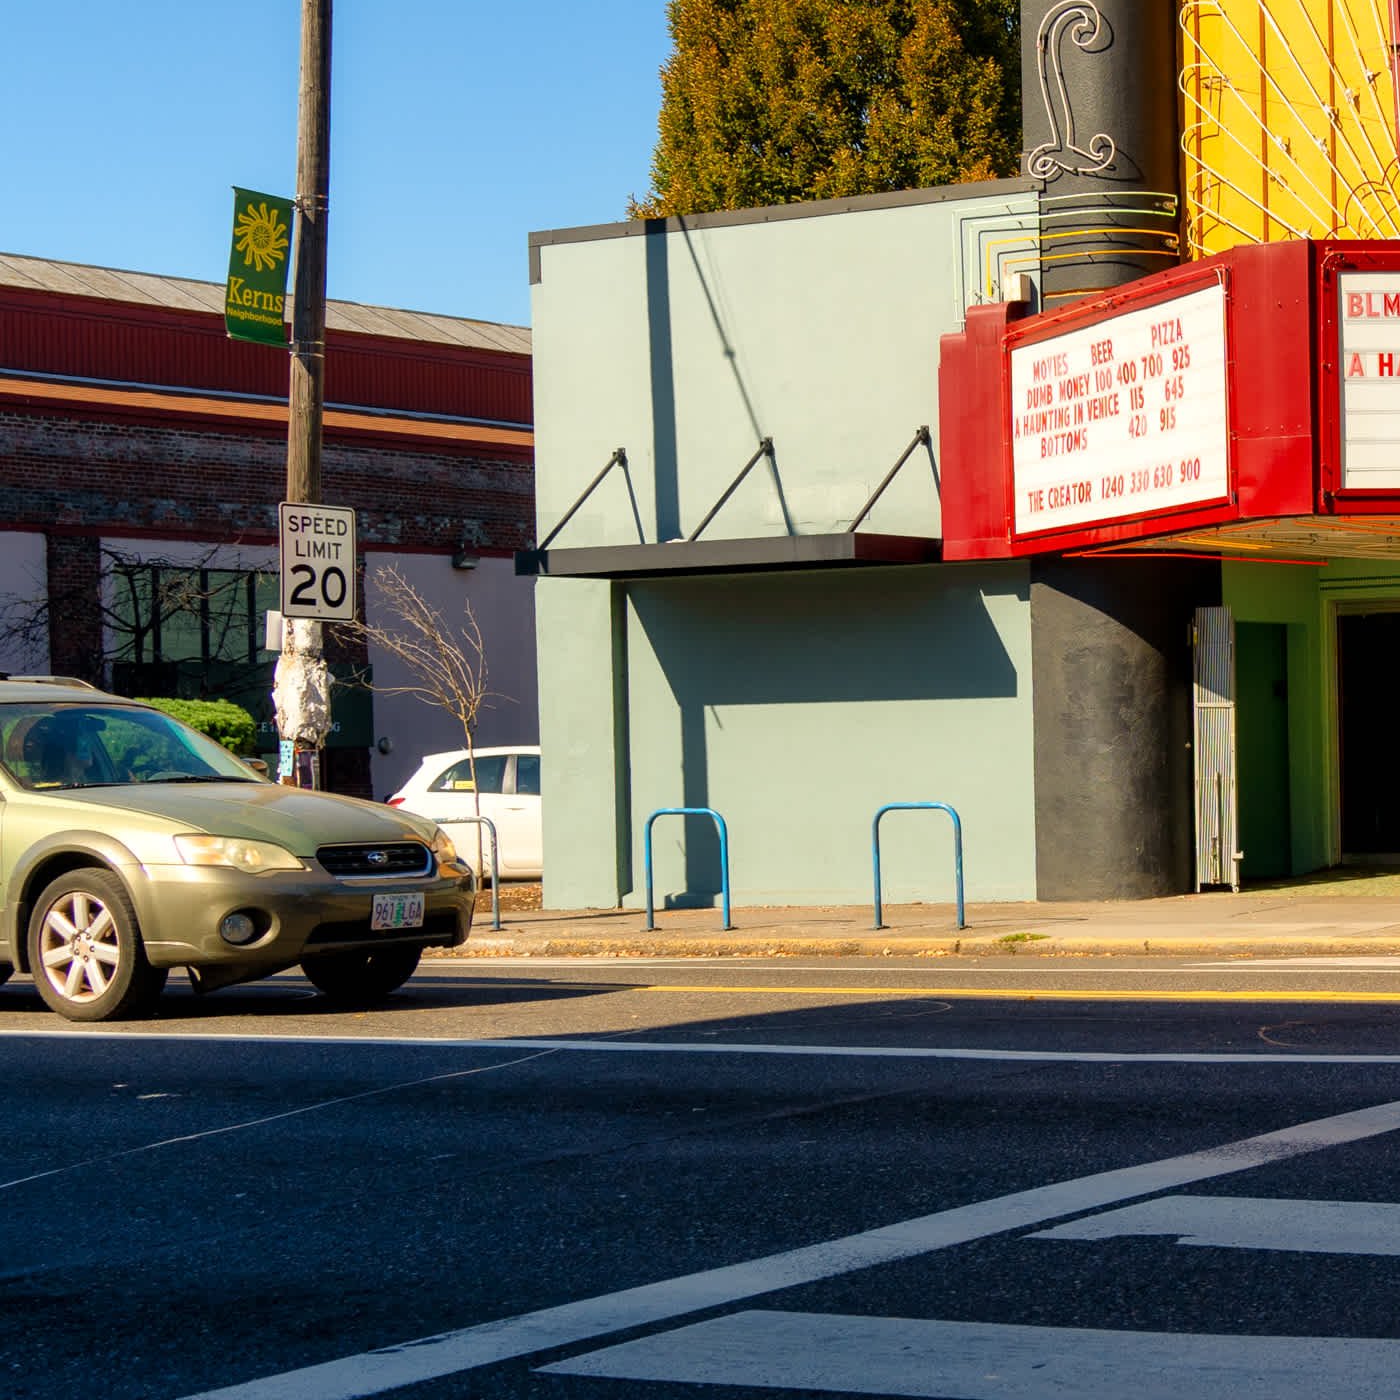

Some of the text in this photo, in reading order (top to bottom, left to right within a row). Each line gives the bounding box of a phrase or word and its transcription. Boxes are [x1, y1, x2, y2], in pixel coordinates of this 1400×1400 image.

[228, 276, 284, 313] Kerns
[227, 306, 283, 326] Neighborhood
[1033, 318, 1183, 382] MOVIES BEER PIZZA
[1349, 352, 1364, 377] A
[1027, 345, 1191, 411] DUMB MONEY 100 400 700 925
[1015, 376, 1184, 438] A HAUNTING IN VENICE 115 645
[1041, 407, 1176, 458] BOTTOMS 420 915
[1028, 458, 1200, 513] THE CREATOR 1240 330 630 900
[288, 515, 347, 536] SPEED
[296, 540, 342, 560] LIMIT
[290, 564, 346, 608] 20
[376, 903, 394, 921] 961
